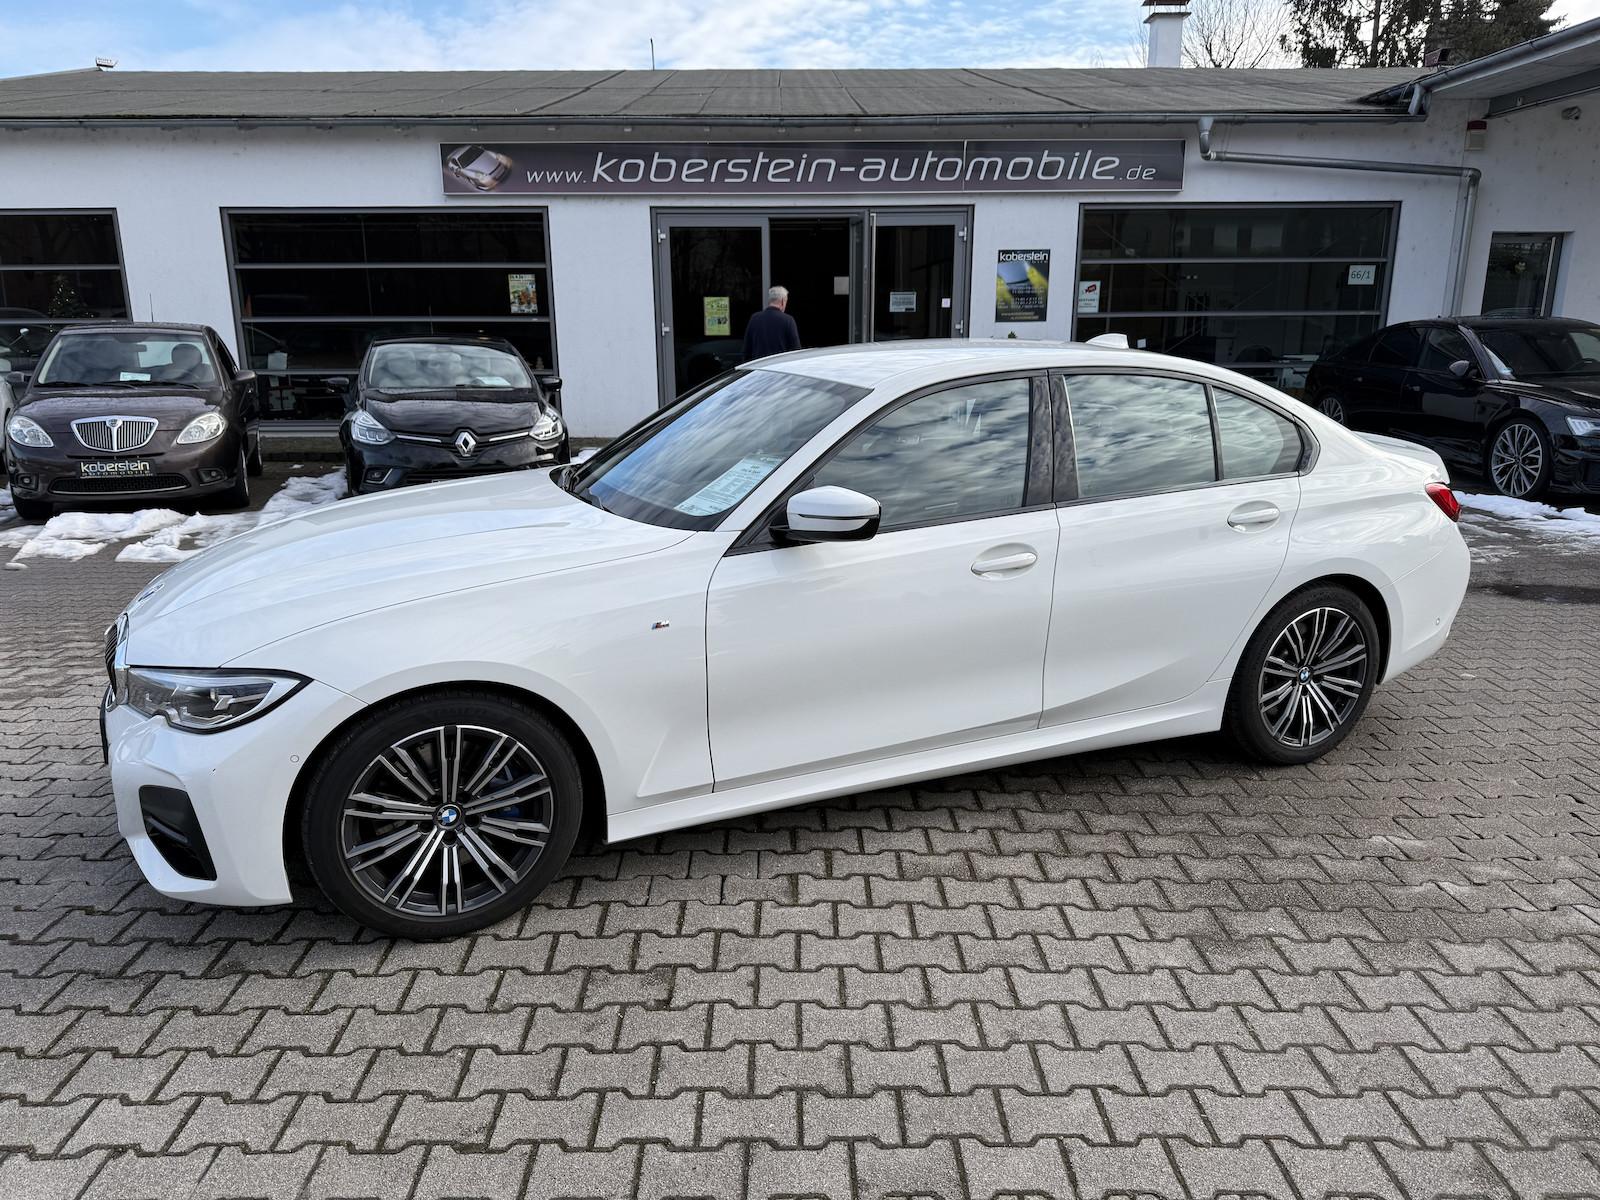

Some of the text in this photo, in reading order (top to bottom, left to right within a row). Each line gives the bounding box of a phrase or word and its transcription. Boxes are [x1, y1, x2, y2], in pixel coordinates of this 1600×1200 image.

[999, 251, 1048, 261] koberstein
[1351, 270, 1370, 280] 66/1
[80, 460, 150, 473] koberstein
